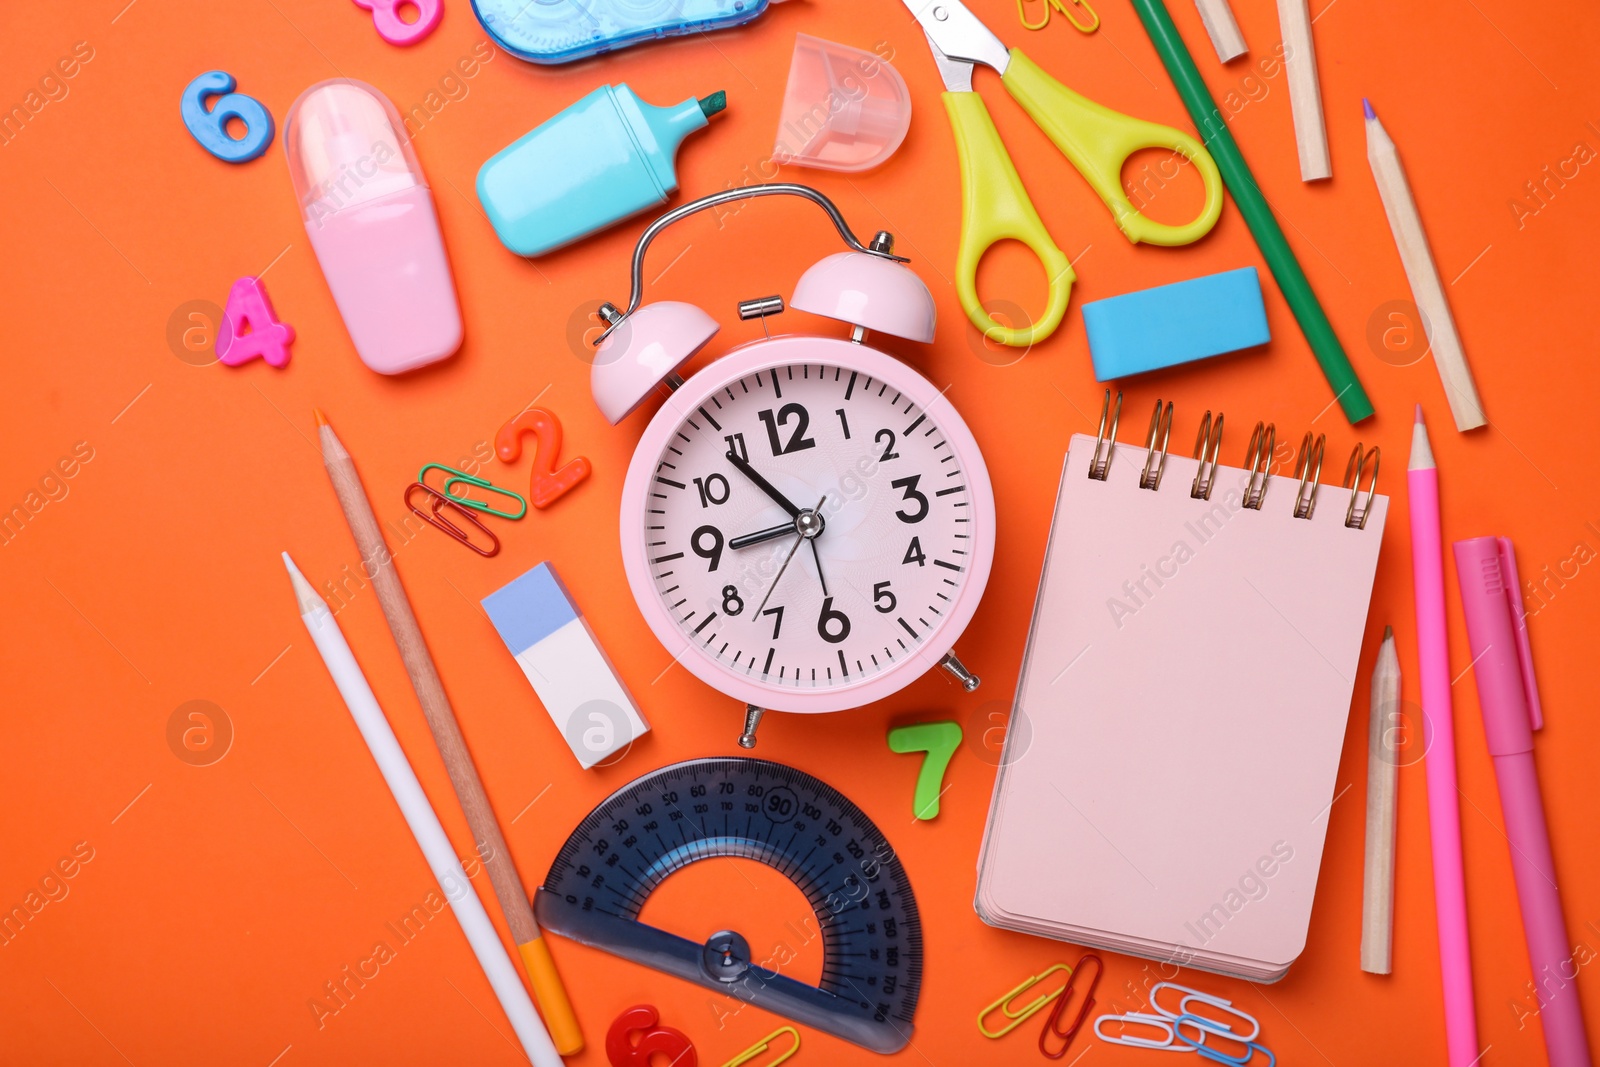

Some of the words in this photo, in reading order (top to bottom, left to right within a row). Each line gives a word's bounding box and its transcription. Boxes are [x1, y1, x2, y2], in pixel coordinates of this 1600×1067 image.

[180, 69, 275, 163] 6
[214, 275, 296, 369] 4
[758, 402, 816, 456] 12
[836, 408, 851, 440] 1
[724, 432, 750, 464] 11
[874, 428, 900, 462] 2
[494, 406, 592, 510] 2
[692, 472, 730, 508] 10
[891, 474, 930, 524] 3
[690, 524, 724, 572] 9
[902, 536, 926, 567] 4
[722, 584, 744, 616] 8
[873, 581, 897, 613] 5
[762, 606, 784, 640] 7
[817, 596, 851, 644] 6
[887, 720, 963, 820] 7
[690, 785, 706, 798] 60
[720, 782, 734, 794] 70
[748, 785, 764, 797] 80
[662, 792, 678, 806] 50
[721, 802, 733, 810] 110
[745, 803, 758, 813] 100
[768, 795, 792, 816] 90
[635, 803, 653, 817] 40
[668, 810, 682, 822] 130
[694, 804, 708, 814] 120
[802, 802, 822, 820] 100
[612, 819, 629, 836] 30
[644, 820, 658, 833] 140
[826, 818, 842, 836] 110
[593, 839, 609, 855] 20
[622, 835, 638, 848] 150
[815, 835, 826, 846] 70
[846, 838, 864, 860] 120
[576, 865, 590, 878] 10
[592, 874, 605, 889] 170
[566, 895, 577, 904] 0
[876, 888, 890, 910] 140
[866, 922, 876, 934] 30
[883, 916, 898, 938] 150
[870, 948, 879, 960] 20
[886, 946, 898, 966] 160
[867, 976, 876, 986] 10
[883, 976, 896, 994] 170
[605, 1004, 698, 1067] 6
